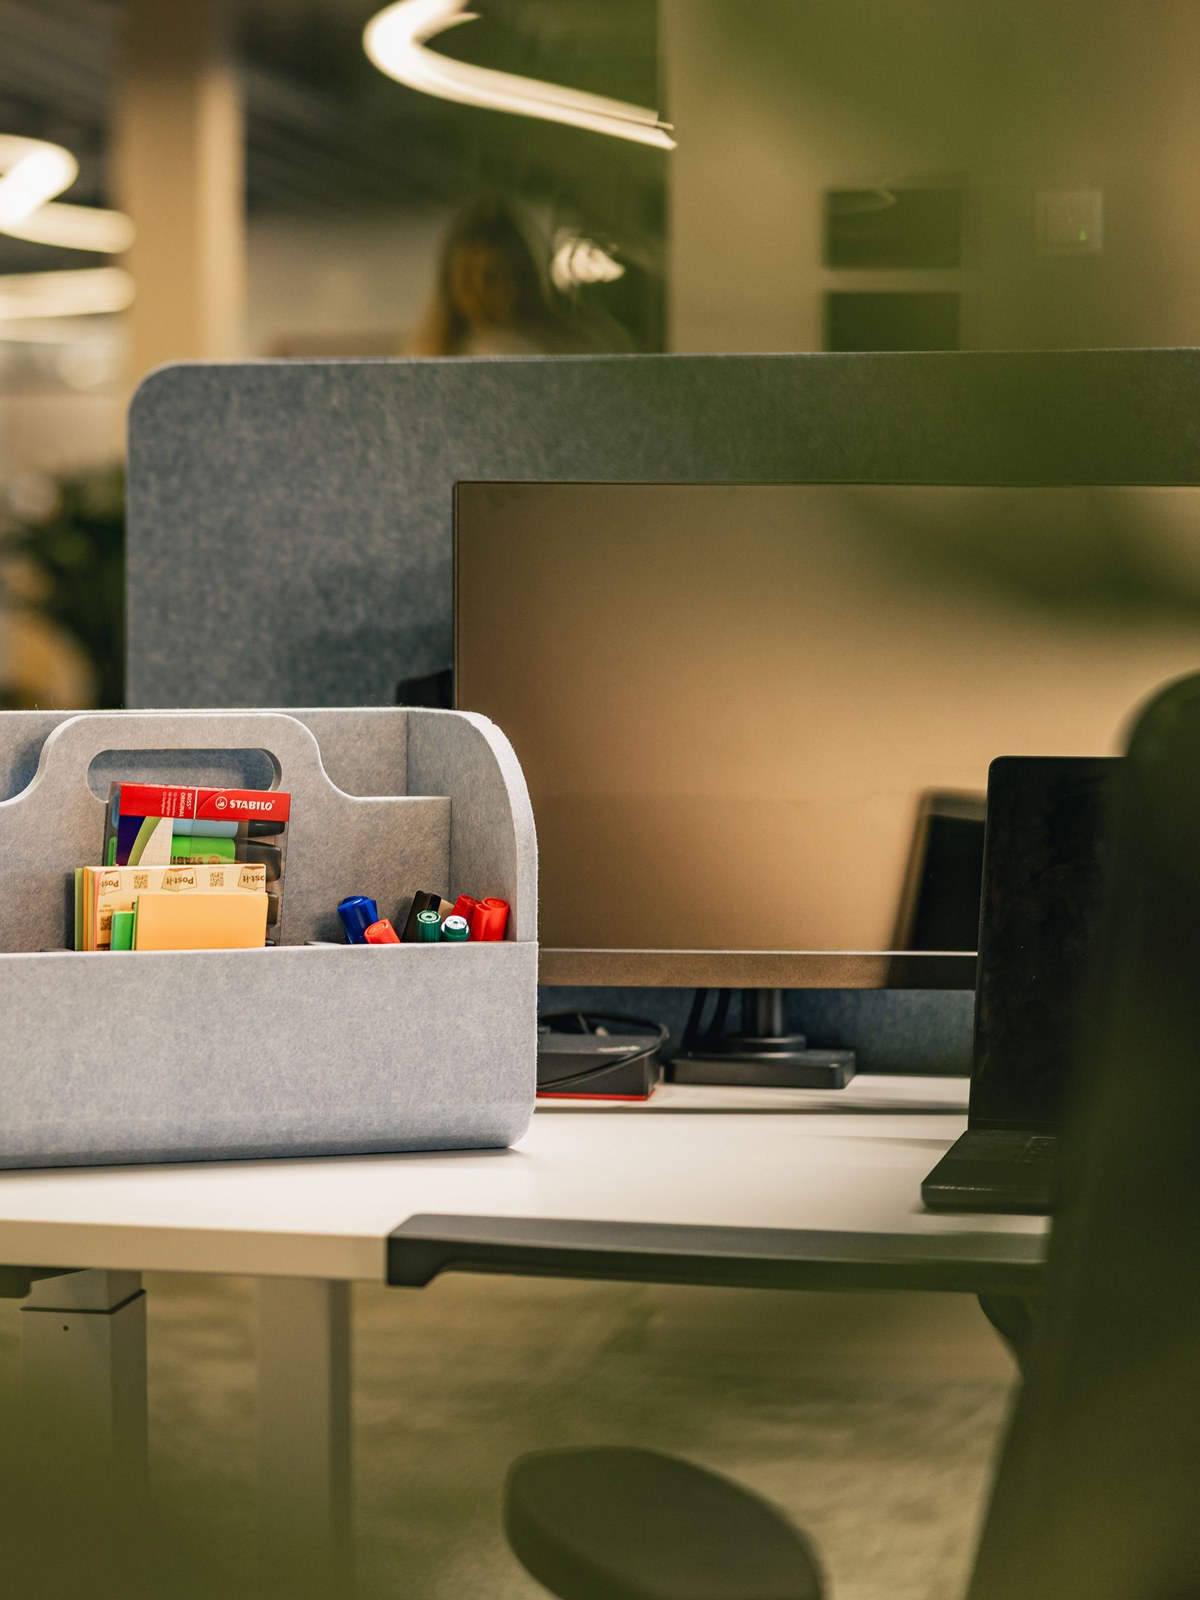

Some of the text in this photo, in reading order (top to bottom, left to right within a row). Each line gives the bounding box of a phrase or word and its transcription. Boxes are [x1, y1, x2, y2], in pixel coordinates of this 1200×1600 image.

[230, 799, 273, 811] STABILO
[166, 875, 194, 885] Post-it
[243, 874, 265, 883] ost-it
